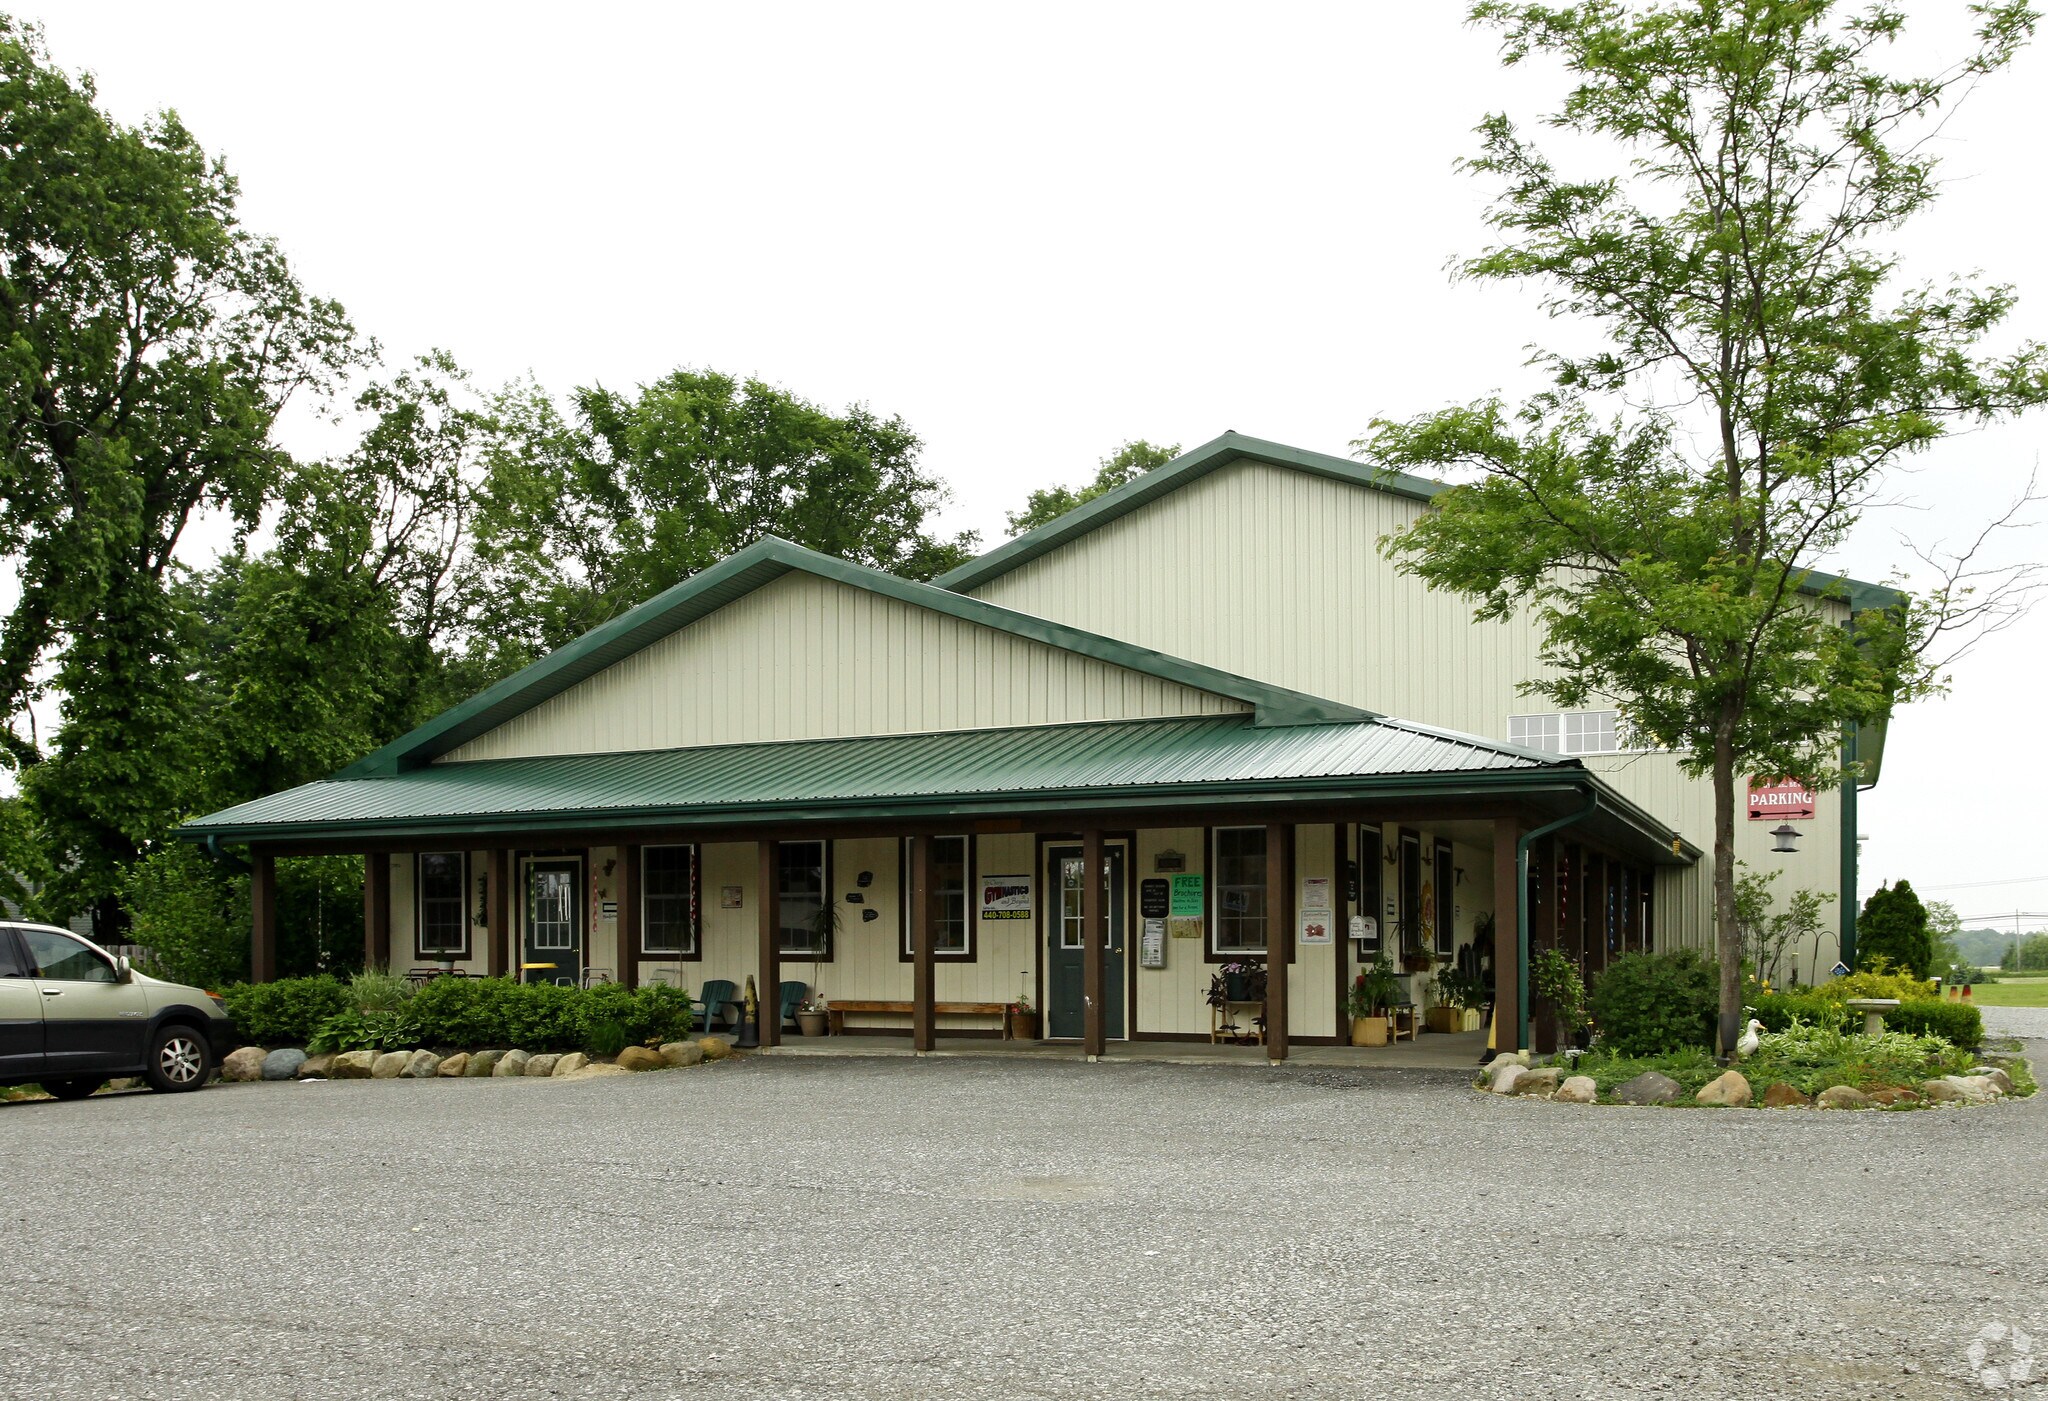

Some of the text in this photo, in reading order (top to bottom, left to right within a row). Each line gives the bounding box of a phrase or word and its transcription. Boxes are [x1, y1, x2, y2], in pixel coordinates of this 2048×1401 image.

[1750, 792, 1813, 805] PARKING
[1174, 877, 1201, 888] FREE
[984, 886, 1029, 905] GYMNASTICS
[984, 911, 1029, 919] 440-708-0588
